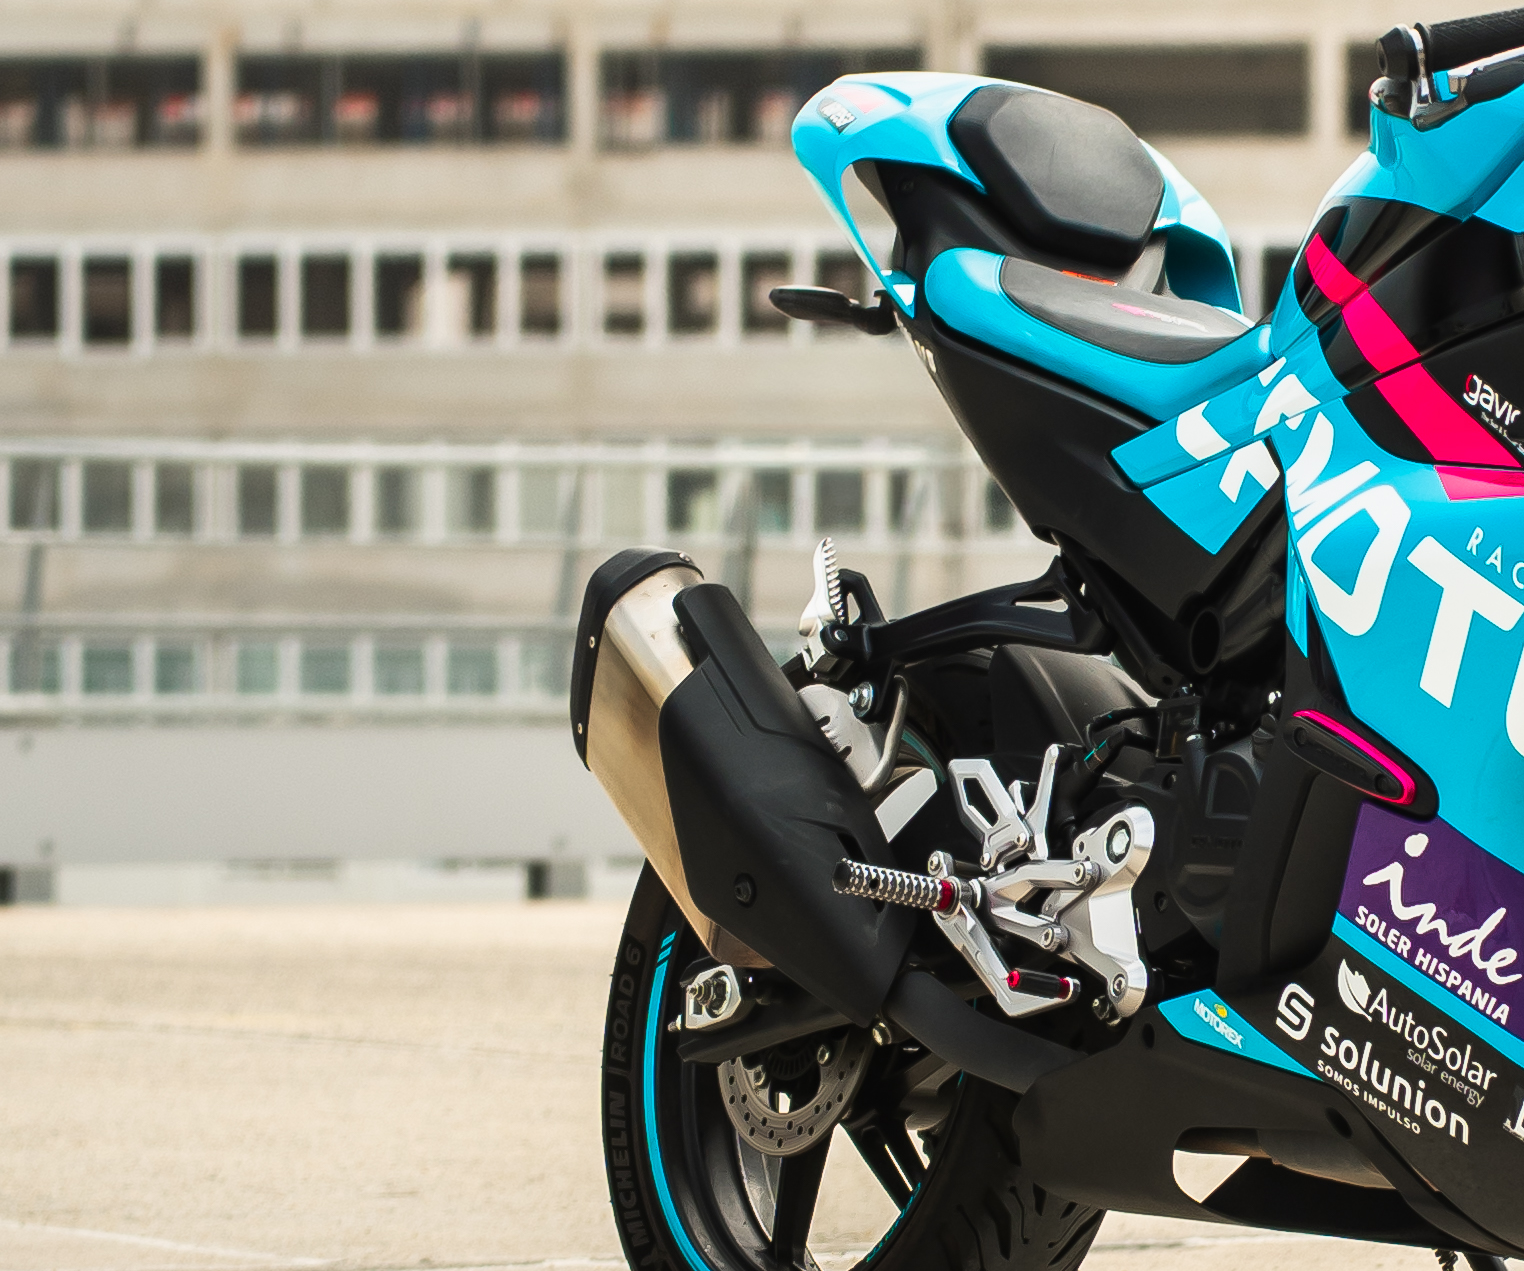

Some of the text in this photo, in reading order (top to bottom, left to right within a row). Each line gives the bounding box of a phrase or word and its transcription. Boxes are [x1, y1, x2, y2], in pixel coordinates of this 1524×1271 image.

[610, 942, 642, 1062] ROAD 6
[1354, 905, 1510, 1025] SOLER HISPANIA
[1317, 1059, 1421, 1135] SOMOS IMPULSO
[1320, 1026, 1470, 1146] solunion
[1369, 988, 1498, 1092] AutoSolar
[1406, 1048, 1485, 1109] solar energy
[608, 1090, 650, 1248] MICHELIN
